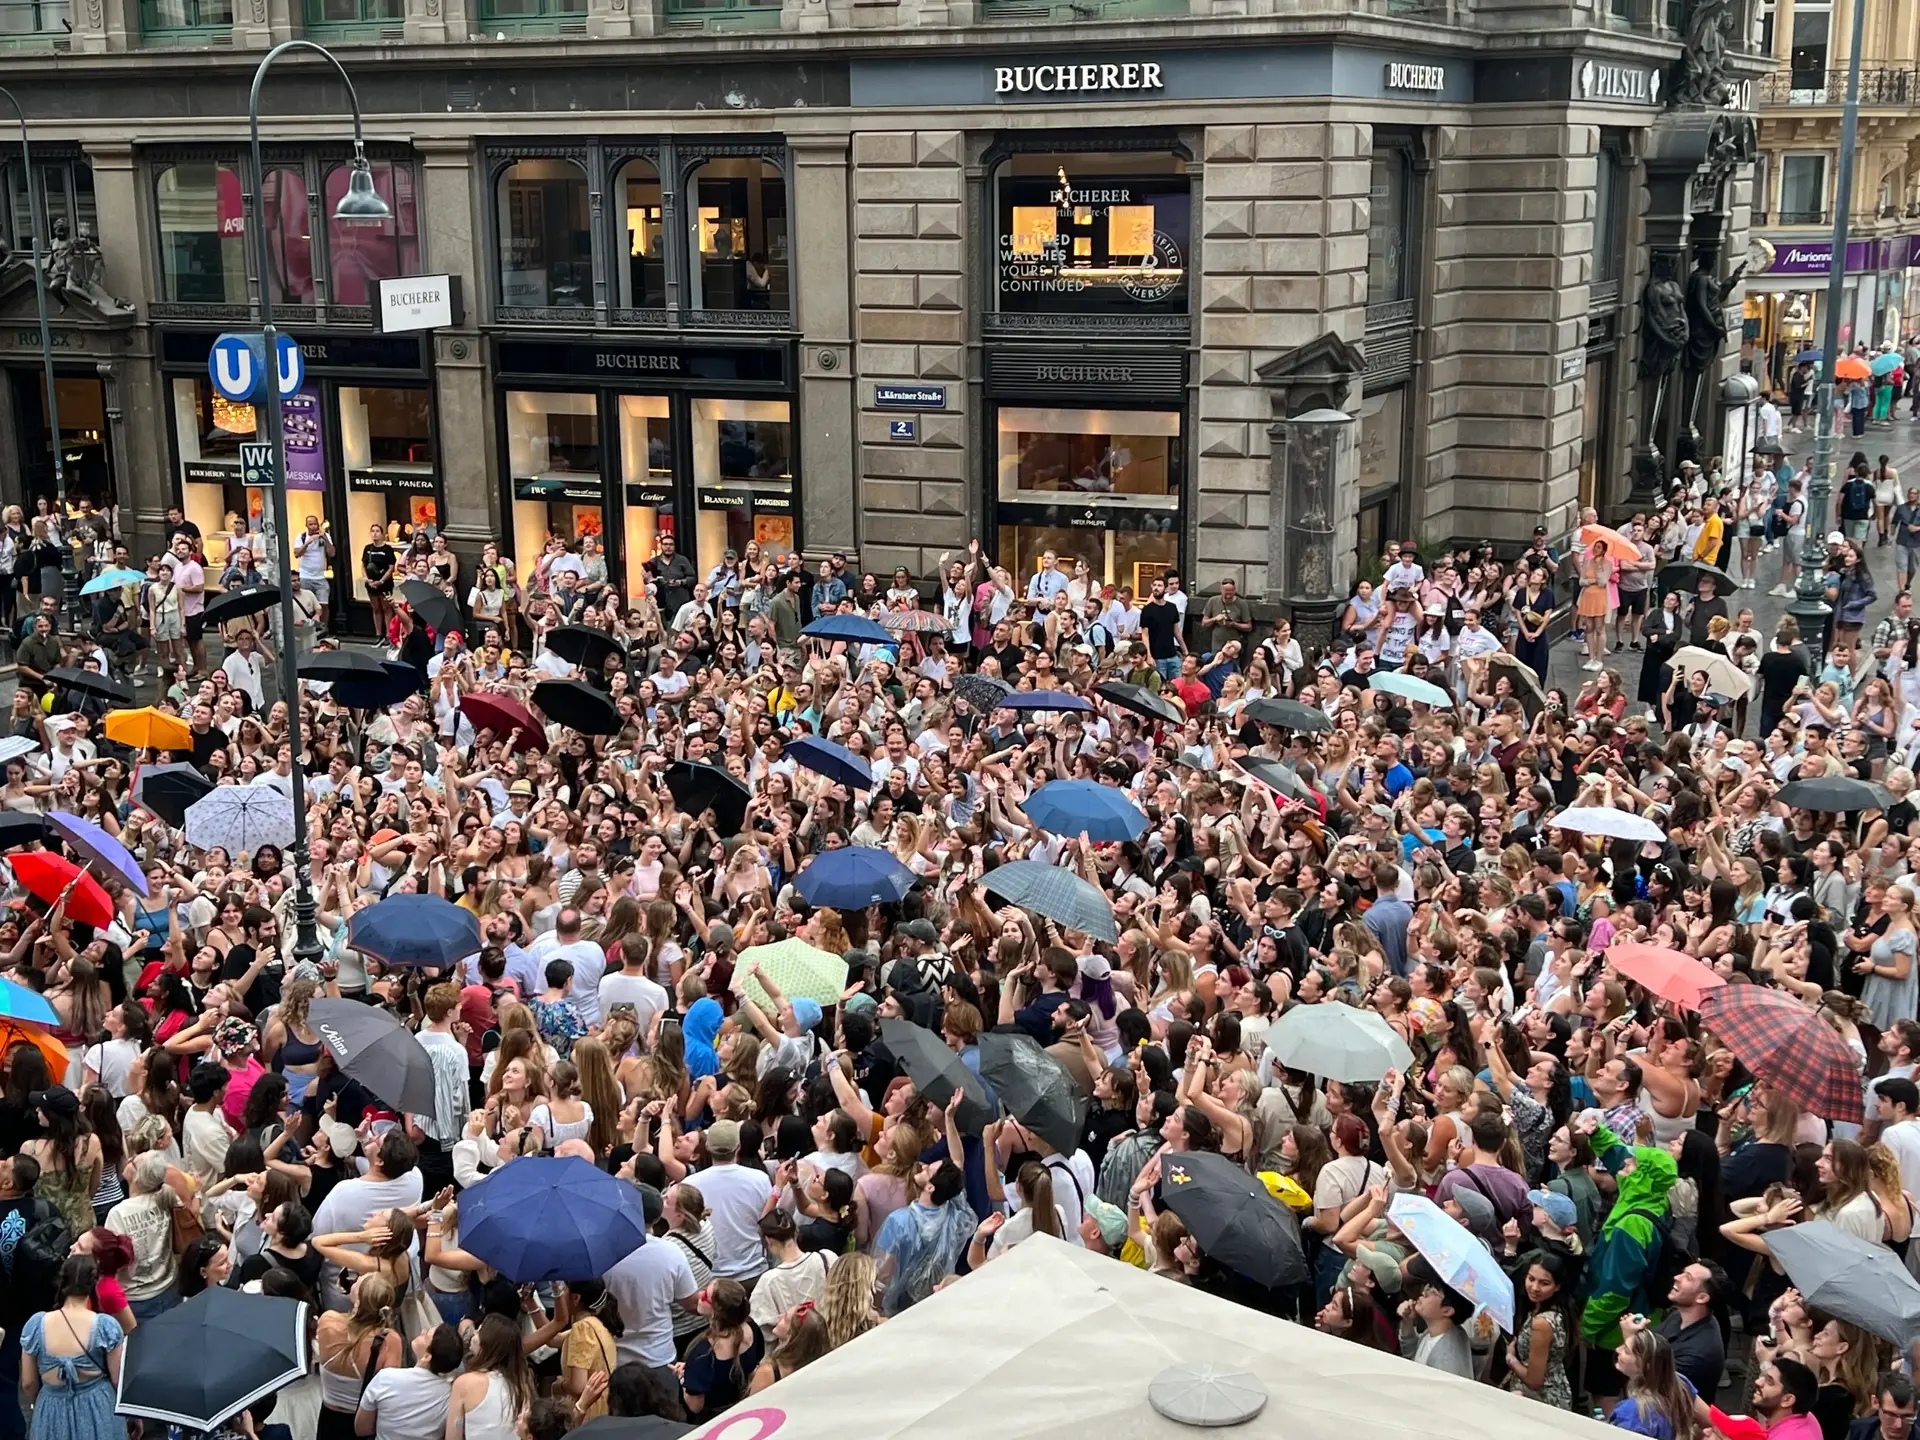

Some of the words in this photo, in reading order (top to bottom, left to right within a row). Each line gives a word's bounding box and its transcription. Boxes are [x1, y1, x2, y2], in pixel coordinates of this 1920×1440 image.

[994, 62, 1164, 93] BUCHERER
[1389, 62, 1444, 90] BUCHERER
[1596, 65, 1646, 98] PILSTL
[1050, 189, 1131, 203] BUCHERER
[1000, 265, 1047, 277] YOURS
[1000, 280, 1085, 292] CONTINUED
[390, 290, 441, 307] BUCHERER
[595, 353, 681, 370] BUCHERER
[215, 348, 252, 395] U
[1037, 365, 1133, 382] BUCHERER
[917, 391, 942, 401] Straße
[896, 421, 907, 433] 2
[286, 471, 323, 482] MESSIKA
[355, 478, 393, 487] BREITLING
[530, 486, 547, 495] IWC
[640, 491, 666, 501] Cartier
[704, 494, 744, 505] BLANCPAIN
[754, 498, 790, 507] LONGINES
